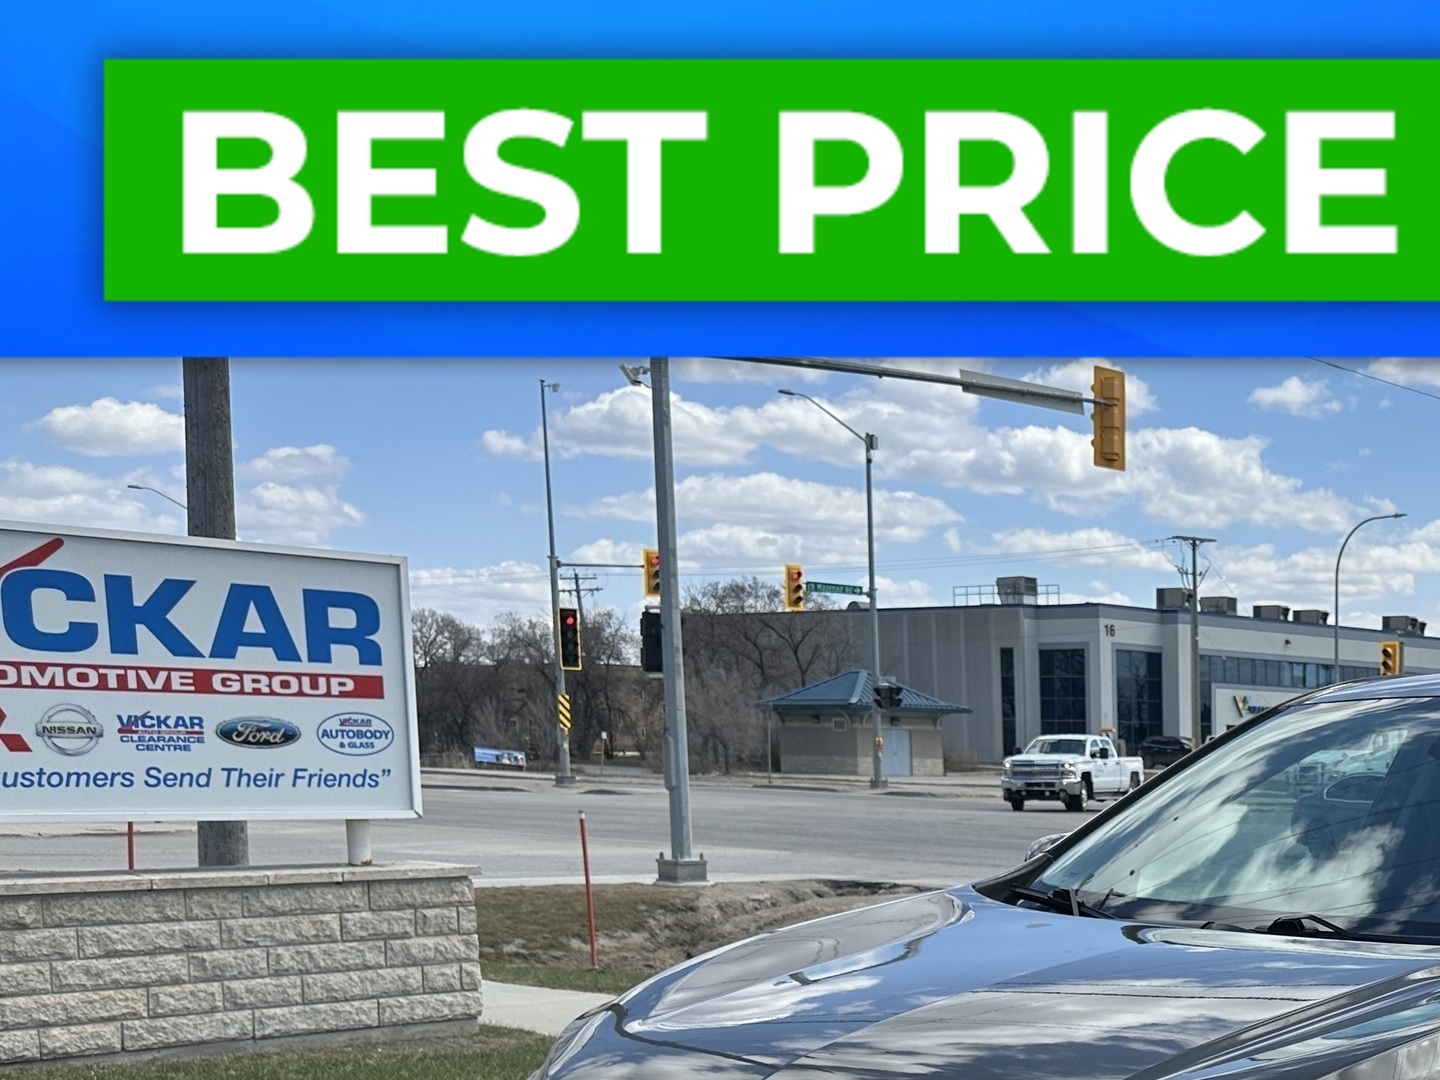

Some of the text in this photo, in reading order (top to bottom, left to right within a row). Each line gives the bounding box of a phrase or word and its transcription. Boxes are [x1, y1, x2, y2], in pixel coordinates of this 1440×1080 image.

[1104, 624, 1116, 638] 16
[212, 672, 356, 696] GROUP
[116, 713, 205, 729] VICKAR
[42, 725, 97, 735] NISSAN
[232, 721, 285, 744] Ford
[321, 729, 391, 740] AUTOBODY
[119, 735, 206, 744] CLEARANCE
[339, 741, 375, 749] & GLASS
[135, 744, 192, 752] CENTRE
[0, 767, 134, 788] ustomers
[143, 767, 212, 788] Send
[220, 767, 285, 788] Their
